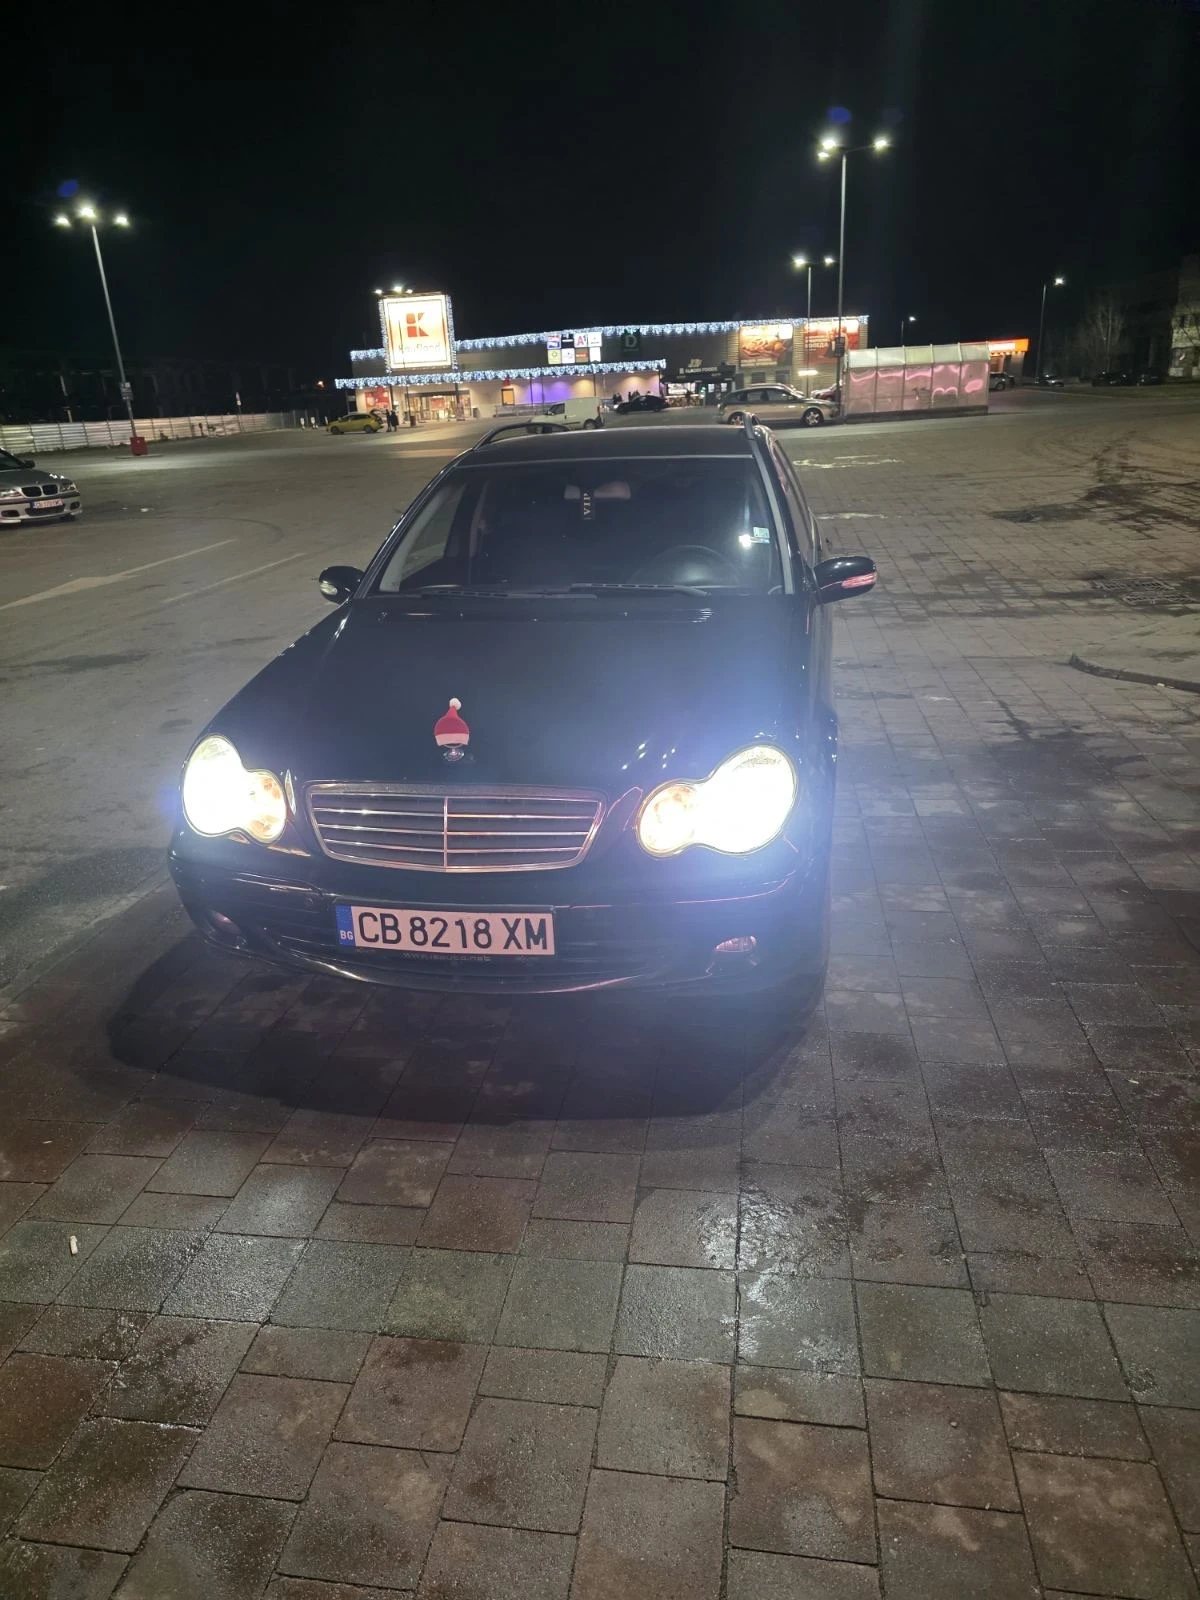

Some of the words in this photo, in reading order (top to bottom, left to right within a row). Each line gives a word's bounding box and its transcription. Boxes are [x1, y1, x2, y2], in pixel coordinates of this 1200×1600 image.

[340, 930, 354, 940] BG
[358, 911, 402, 945] CB
[409, 916, 492, 949] 8218
[501, 917, 548, 950] XM
